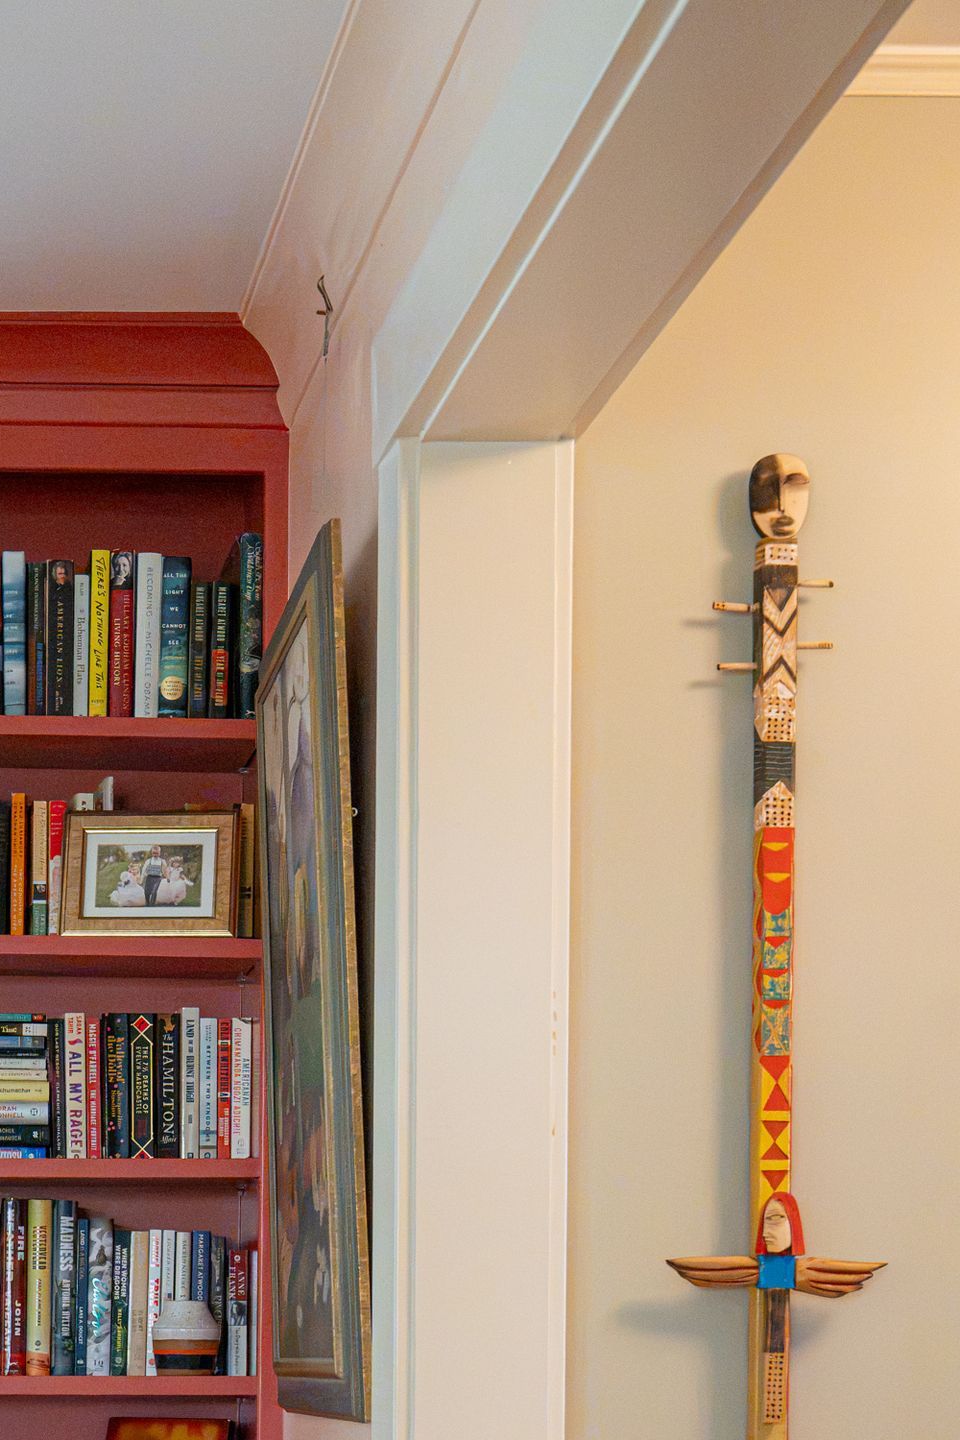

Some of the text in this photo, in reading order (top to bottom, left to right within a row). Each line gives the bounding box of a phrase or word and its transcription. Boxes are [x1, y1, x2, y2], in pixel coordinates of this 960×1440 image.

[56, 602, 64, 653] AMERICAN
[145, 632, 153, 677] MICHELLE
[186, 1020, 195, 1038] LAND
[234, 1028, 242, 1077] CHIMAMANDA
[70, 1051, 83, 1148] ALL MY RAGE
[162, 1043, 175, 1134] HAMILTON
[142, 1104, 149, 1114] OF
[17, 1226, 25, 1260] FIRE
[59, 1215, 74, 1271] MADNESS
[228, 1266, 237, 1300] FRANK
[237, 1270, 247, 1296] ANNE
[14, 1300, 22, 1336] JOHN
